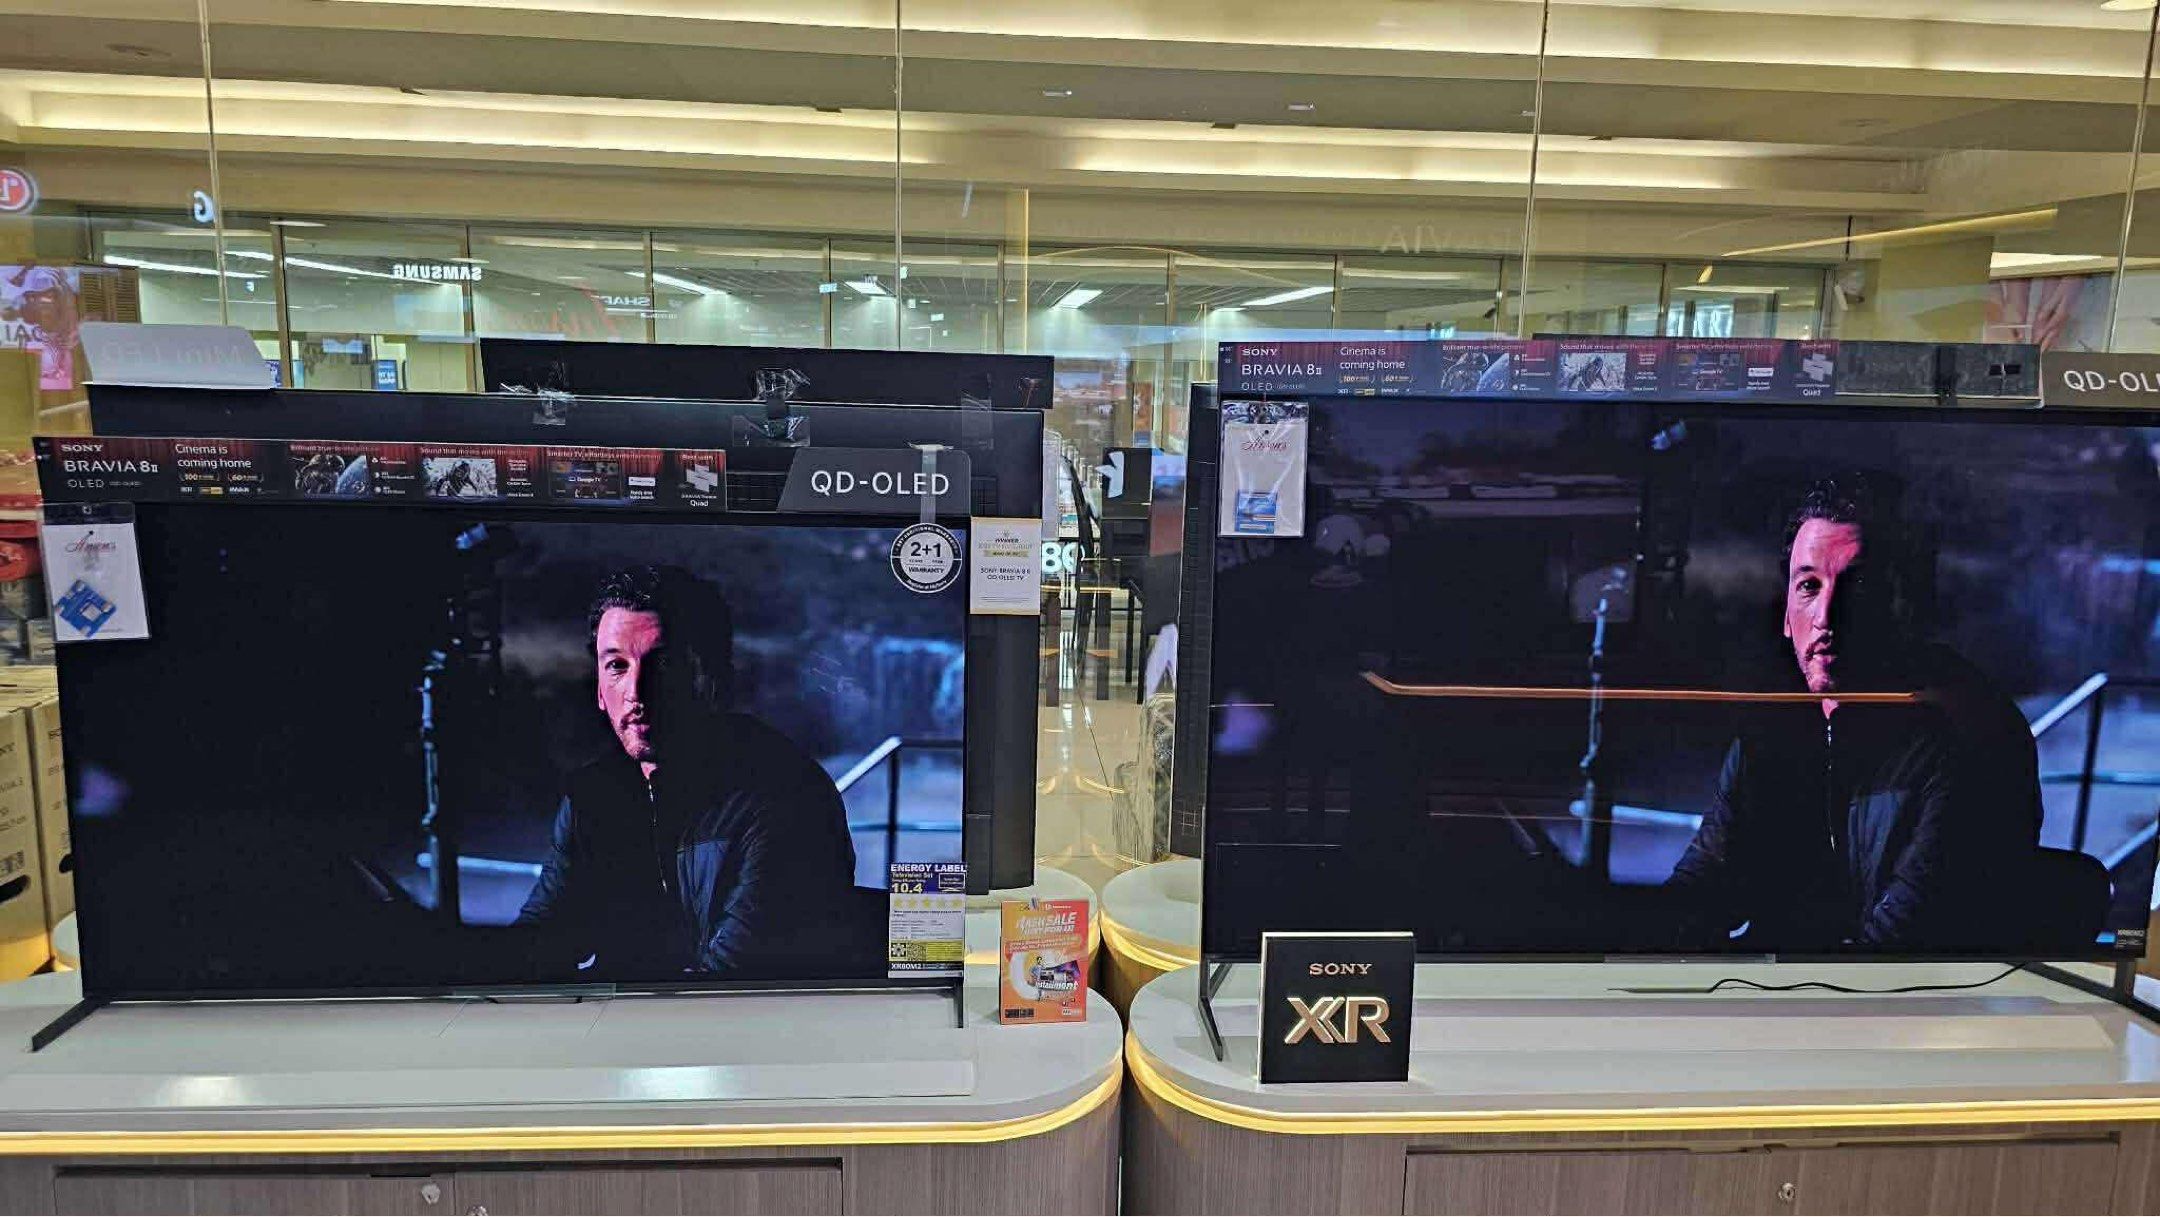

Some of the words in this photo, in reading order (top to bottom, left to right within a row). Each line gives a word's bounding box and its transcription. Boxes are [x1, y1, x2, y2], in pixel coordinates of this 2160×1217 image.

[1241, 348, 1278, 356] SONY
[1339, 346, 1374, 356] Cinema
[1376, 347, 1386, 356] is
[1241, 363, 1303, 376] BRAVIA
[1339, 361, 1374, 371] coming
[1376, 361, 1406, 370] home
[1241, 382, 1273, 391] OLED
[2063, 369, 2160, 393] QD-OL
[60, 444, 103, 452] SONY
[174, 443, 216, 454] Cinema
[218, 445, 228, 454] is
[63, 460, 137, 473] BRAVIA
[177, 459, 218, 469] coming
[219, 459, 252, 468] home
[67, 479, 105, 488] OLED
[810, 469, 950, 497] QD-OLED
[690, 499, 709, 508] Quad
[910, 541, 941, 557] 2+1
[890, 863, 933, 872] ENERGY
[934, 864, 967, 873] LABEL
[891, 882, 923, 893] 10.4
[1046, 911, 1078, 926] SALE
[1309, 963, 1373, 975] SONY
[1284, 996, 1392, 1044] XR
